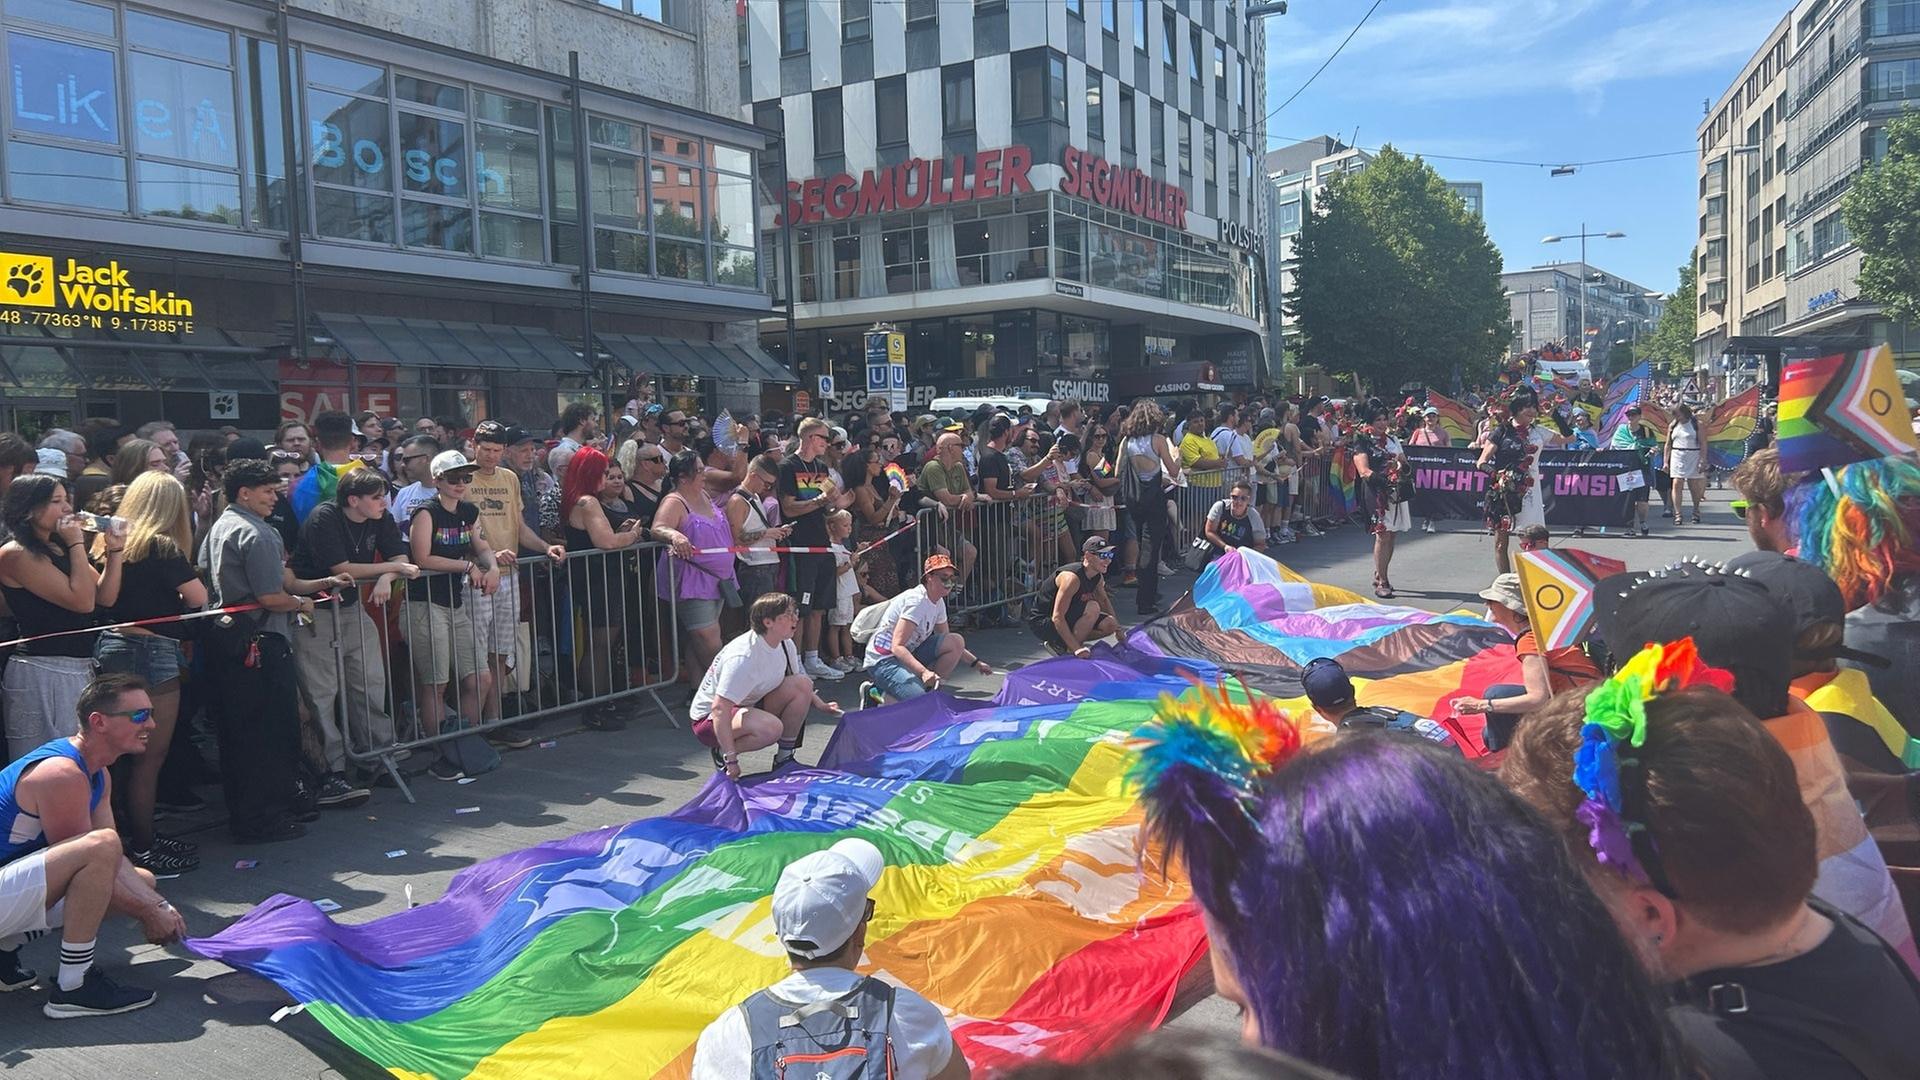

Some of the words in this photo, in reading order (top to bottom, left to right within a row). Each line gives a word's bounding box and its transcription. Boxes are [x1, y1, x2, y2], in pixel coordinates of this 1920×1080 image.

[774, 144, 1036, 227] SEGMÜLLER
[1059, 145, 1188, 231] SEGMÜLLER
[59, 258, 131, 288] Jack
[60, 282, 193, 317] Wolfskin
[871, 367, 885, 384] U
[893, 367, 903, 384] U
[1154, 382, 1191, 393] CASINO
[1052, 379, 1109, 402] SEGMÜLLER
[1416, 469, 1489, 492] NICHT
[1554, 474, 1616, 496] UNS!
